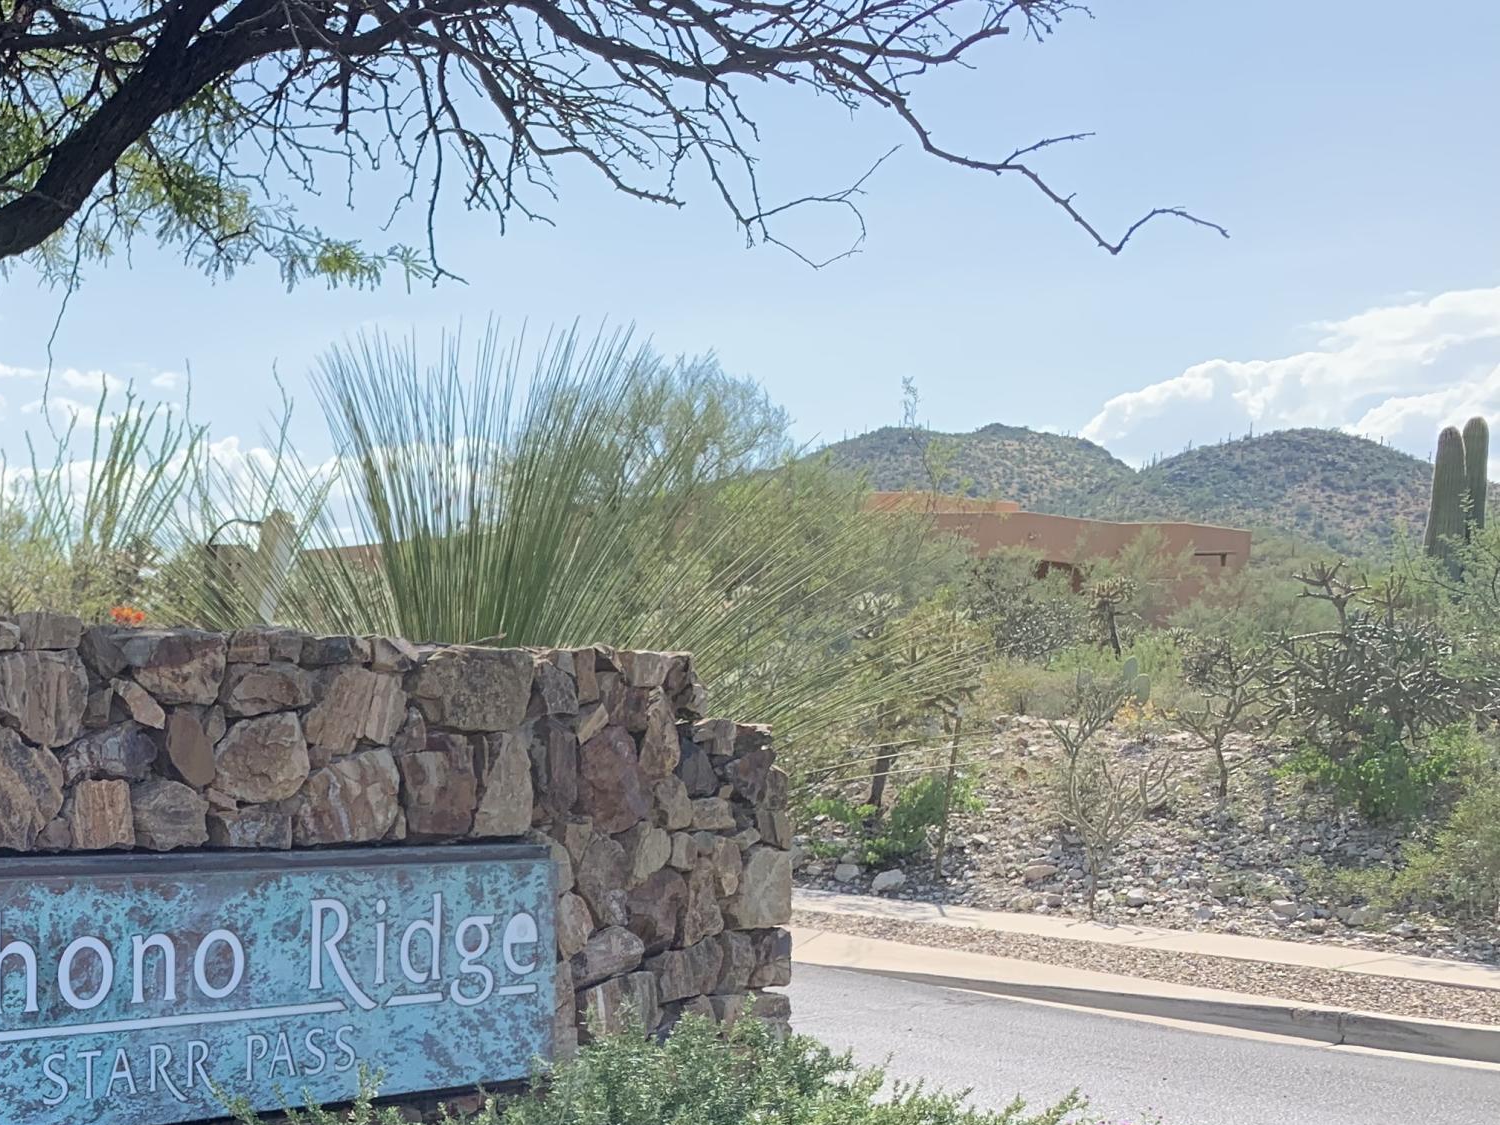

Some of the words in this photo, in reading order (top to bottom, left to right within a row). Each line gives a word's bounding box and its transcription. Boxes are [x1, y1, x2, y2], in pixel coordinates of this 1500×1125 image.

[308, 892, 540, 1011] Ridge
[41, 1039, 216, 1107] STARR
[245, 1024, 357, 1082] PASS
